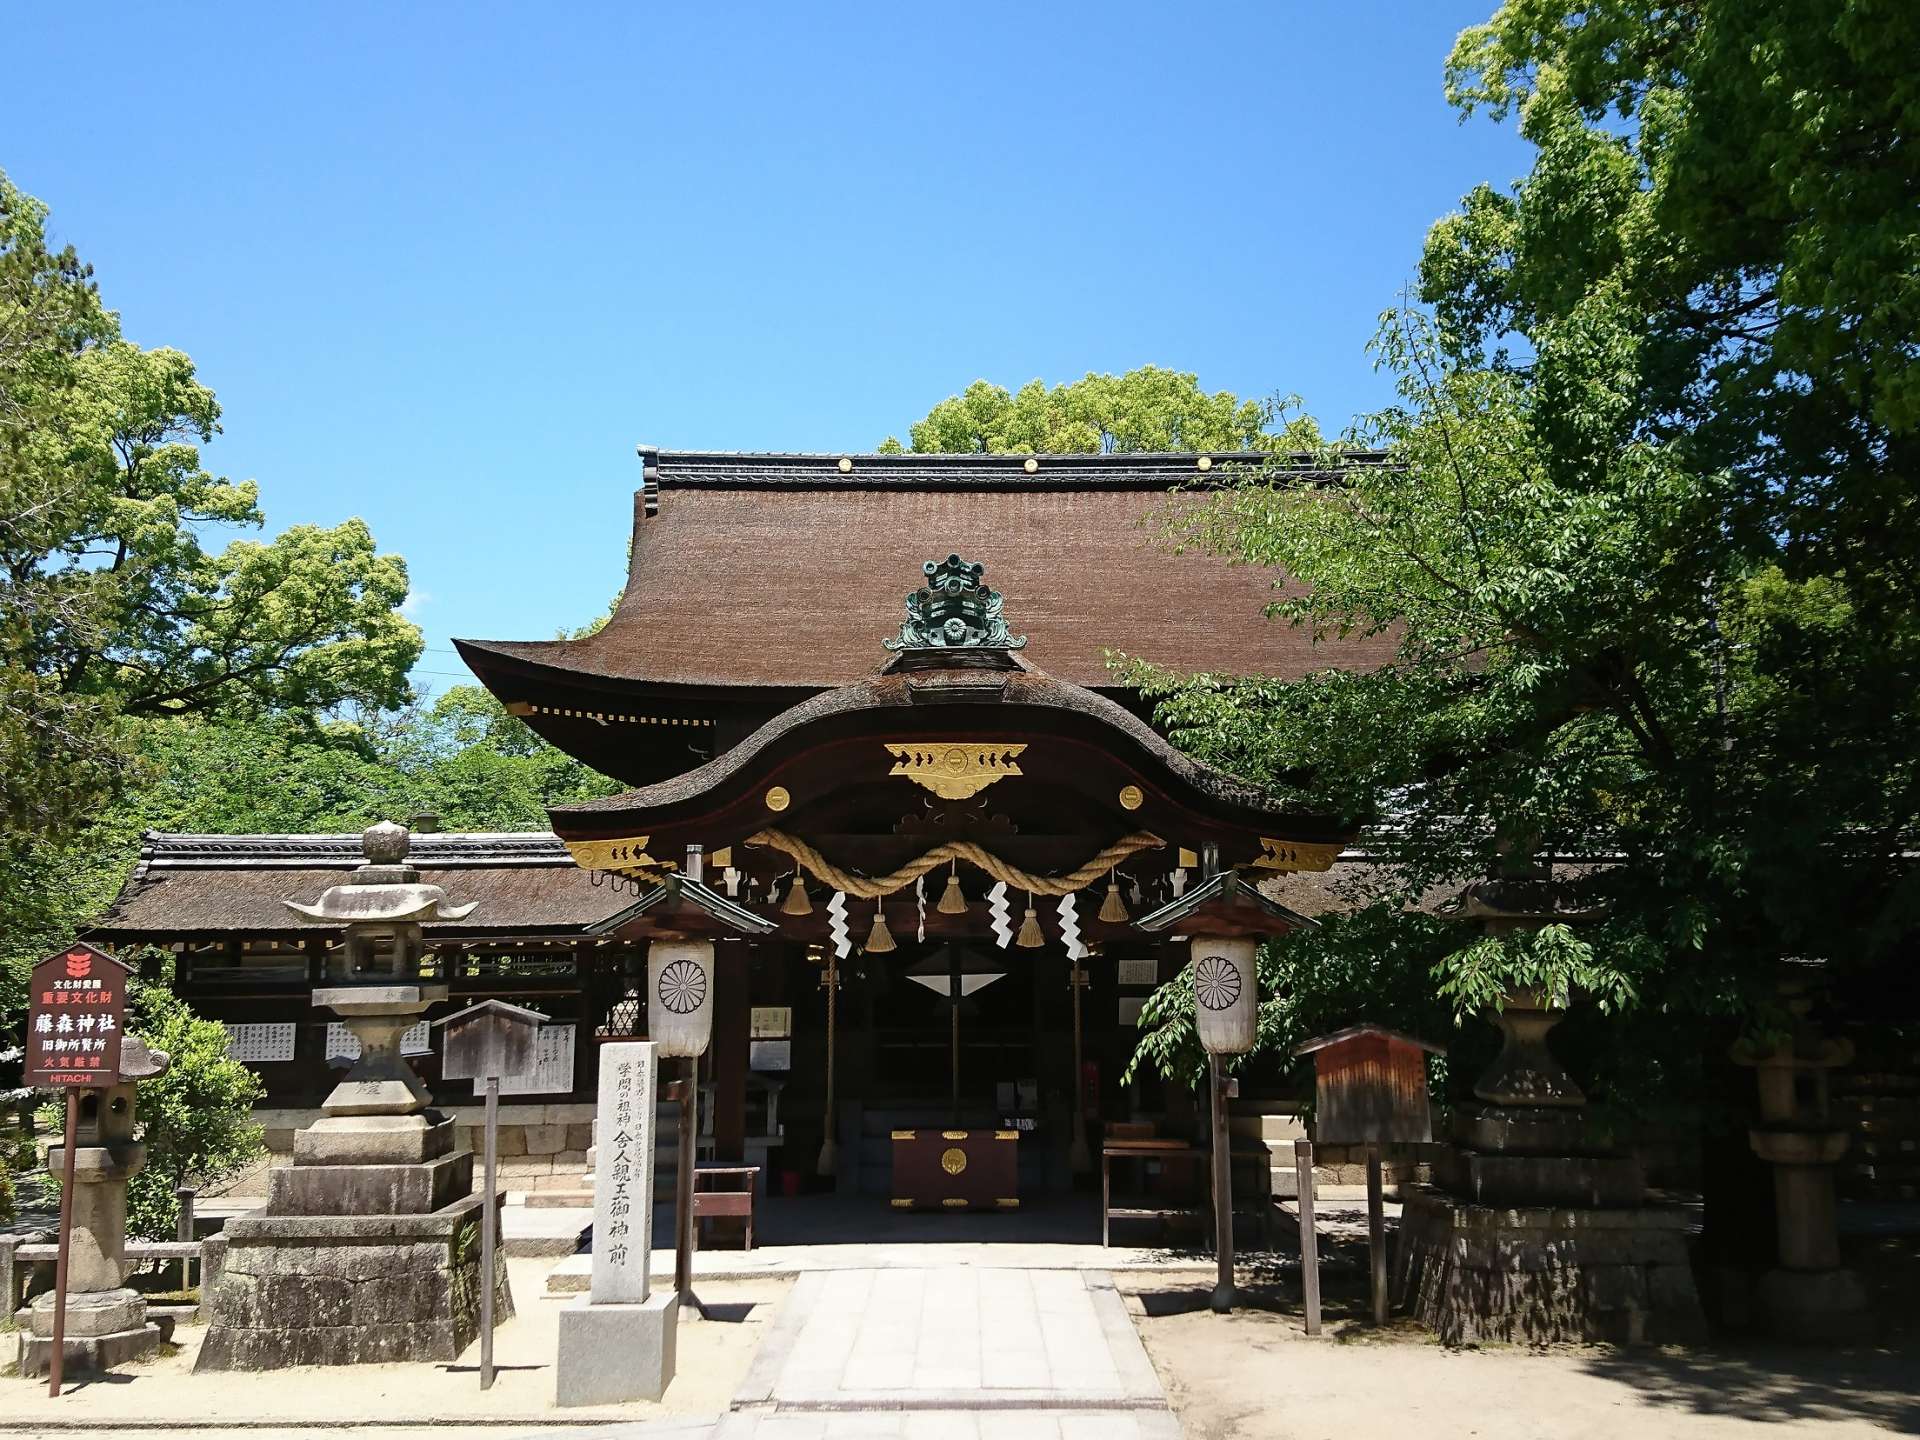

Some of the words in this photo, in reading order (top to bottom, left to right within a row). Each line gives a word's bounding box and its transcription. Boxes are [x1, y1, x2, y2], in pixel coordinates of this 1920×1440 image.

[42, 991, 112, 1004] 重要文化財
[34, 1013, 116, 1033] 藤森神社
[42, 1038, 107, 1052] 旧御所賢所
[44, 1056, 100, 1068] 火気厳禁
[50, 1074, 92, 1083] HITACHI
